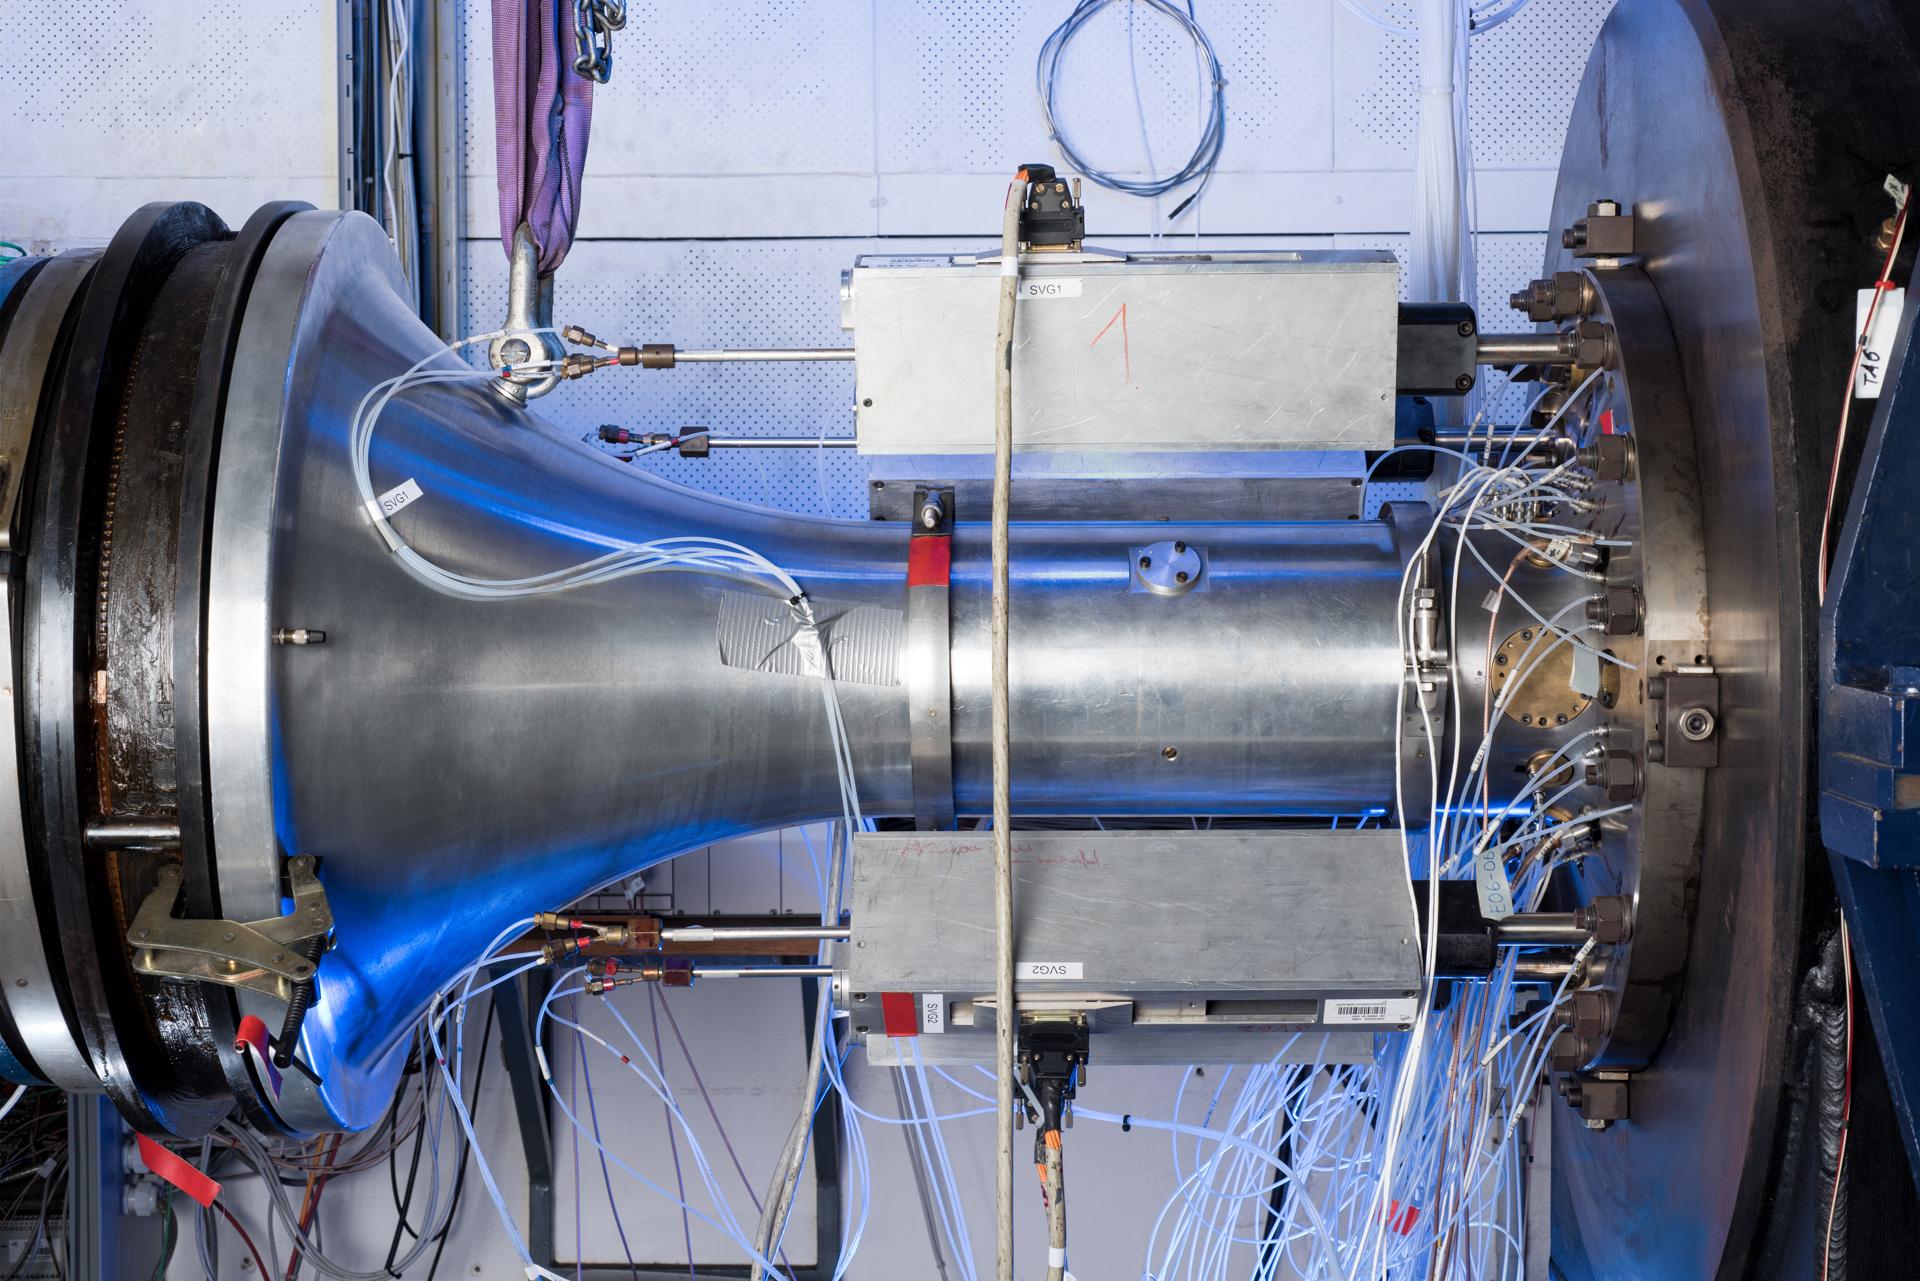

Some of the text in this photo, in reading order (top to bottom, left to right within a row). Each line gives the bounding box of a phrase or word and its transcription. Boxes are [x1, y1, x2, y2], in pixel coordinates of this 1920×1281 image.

[1029, 284, 1061, 296] SVG1
[384, 491, 409, 511] SVG1
[1032, 965, 1067, 975] SVG2
[927, 1003, 938, 1024] SVG2
